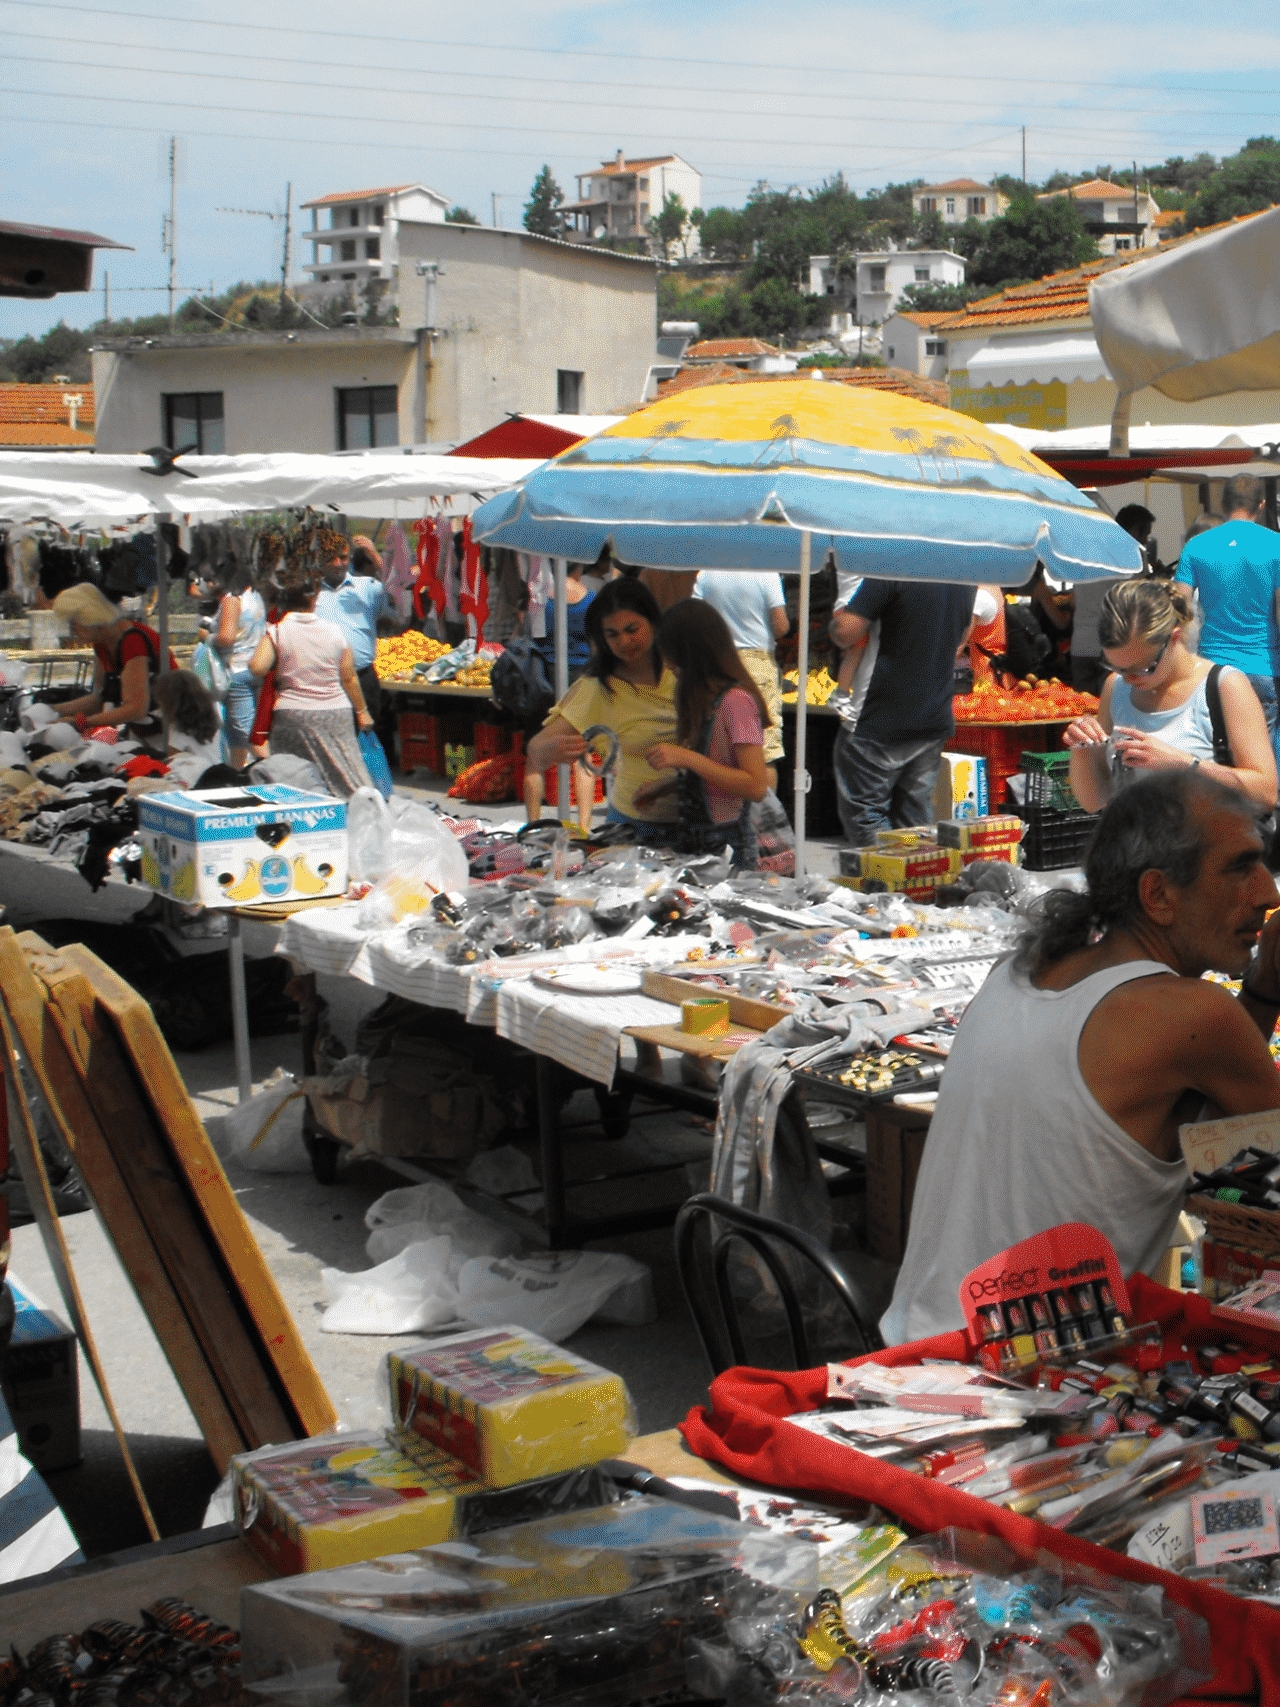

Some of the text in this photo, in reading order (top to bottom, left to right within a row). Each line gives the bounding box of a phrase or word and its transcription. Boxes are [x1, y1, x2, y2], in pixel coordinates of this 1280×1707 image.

[203, 813, 266, 830] PREMIUM
[274, 806, 337, 824] BANANAS
[968, 1256, 1107, 1303] perfect Graffiti
